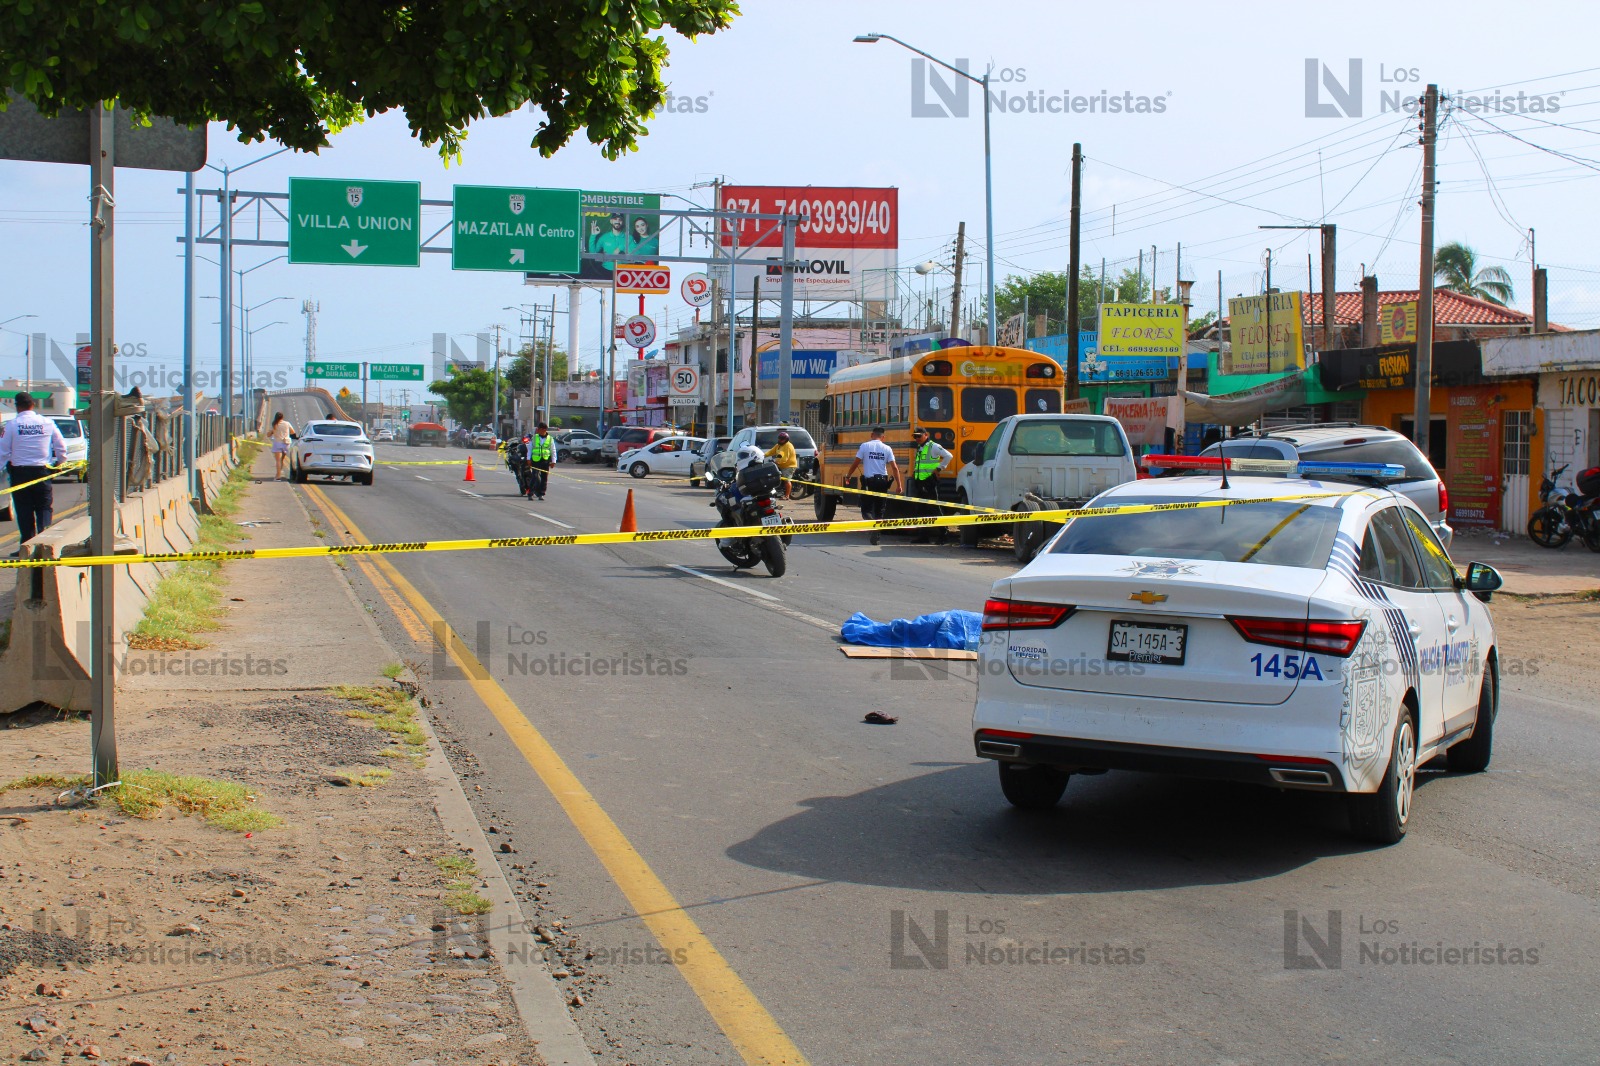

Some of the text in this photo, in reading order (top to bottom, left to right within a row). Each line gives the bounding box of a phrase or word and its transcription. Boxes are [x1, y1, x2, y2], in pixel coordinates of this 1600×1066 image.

[350, 194, 360, 203] 15
[581, 194, 644, 205] OMBUSTIBLE
[512, 203, 522, 211] 15
[298, 214, 412, 230] VILLA UNION
[458, 221, 575, 238] MAZATLAN Centro
[617, 271, 668, 288] OXXO
[806, 278, 850, 286] Espectaculares
[1104, 307, 1179, 318] TAPICERIA
[1111, 327, 1174, 341] FLORES
[677, 373, 692, 384] 50
[1559, 376, 1600, 405] TACO
[1112, 631, 1183, 651] SA-145A-3
[1129, 650, 1162, 663] Premier
[1251, 653, 1323, 681] 145A
